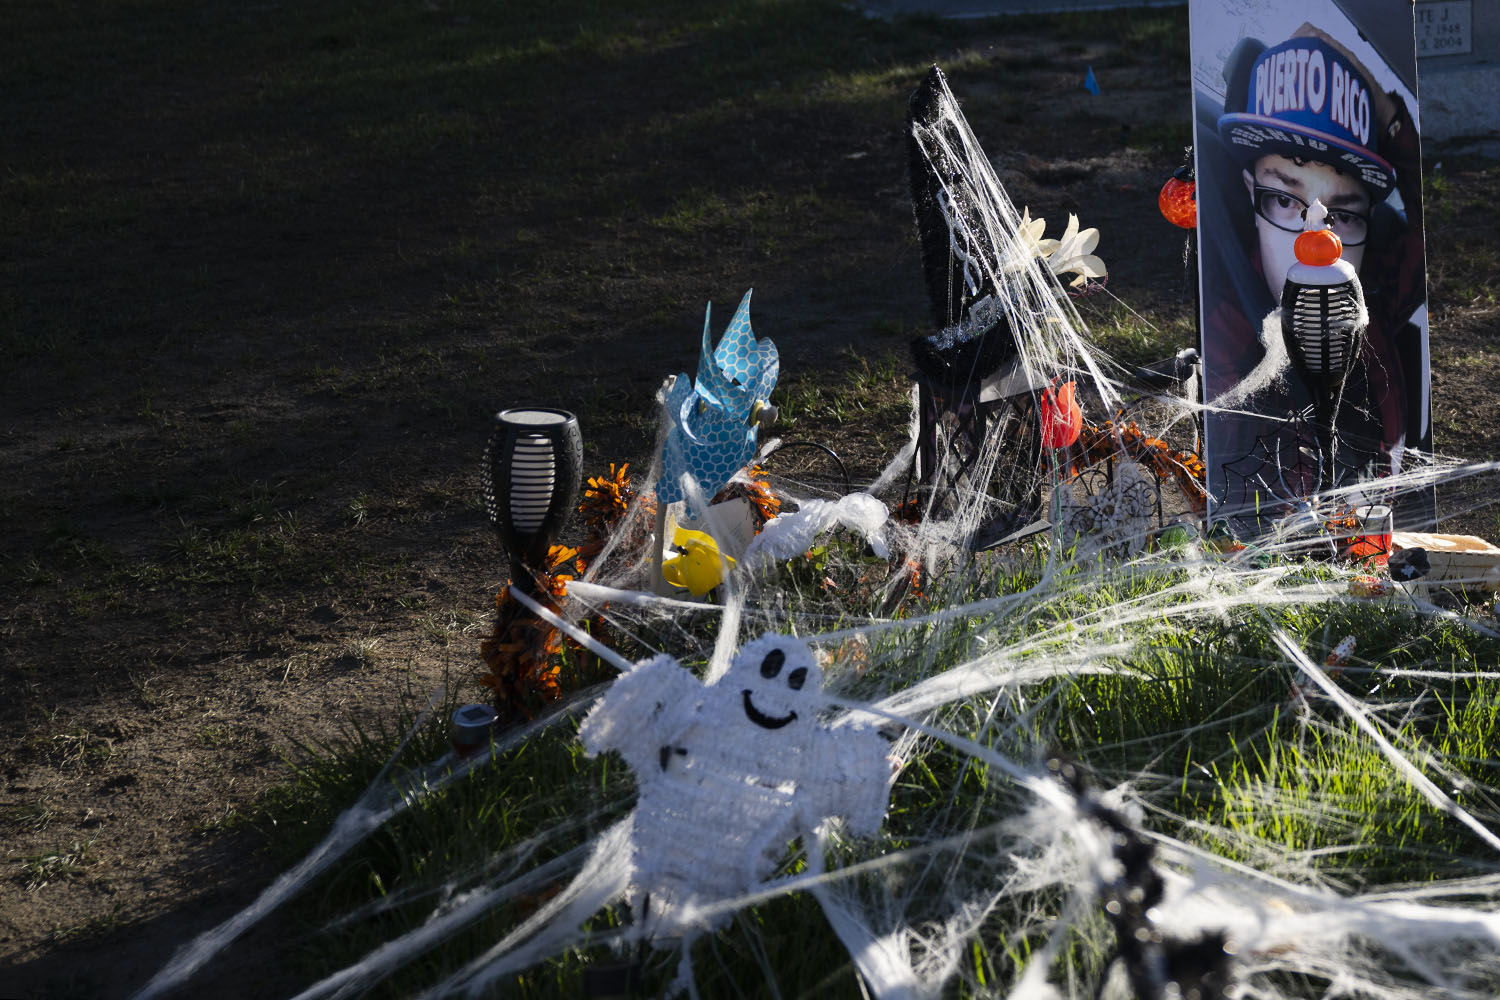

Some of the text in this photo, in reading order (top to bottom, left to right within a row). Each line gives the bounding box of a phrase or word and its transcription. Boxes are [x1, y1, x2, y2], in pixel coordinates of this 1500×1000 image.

[1440, 8, 1449, 22] J
[1255, 48, 1371, 146] PUERTO RICO
